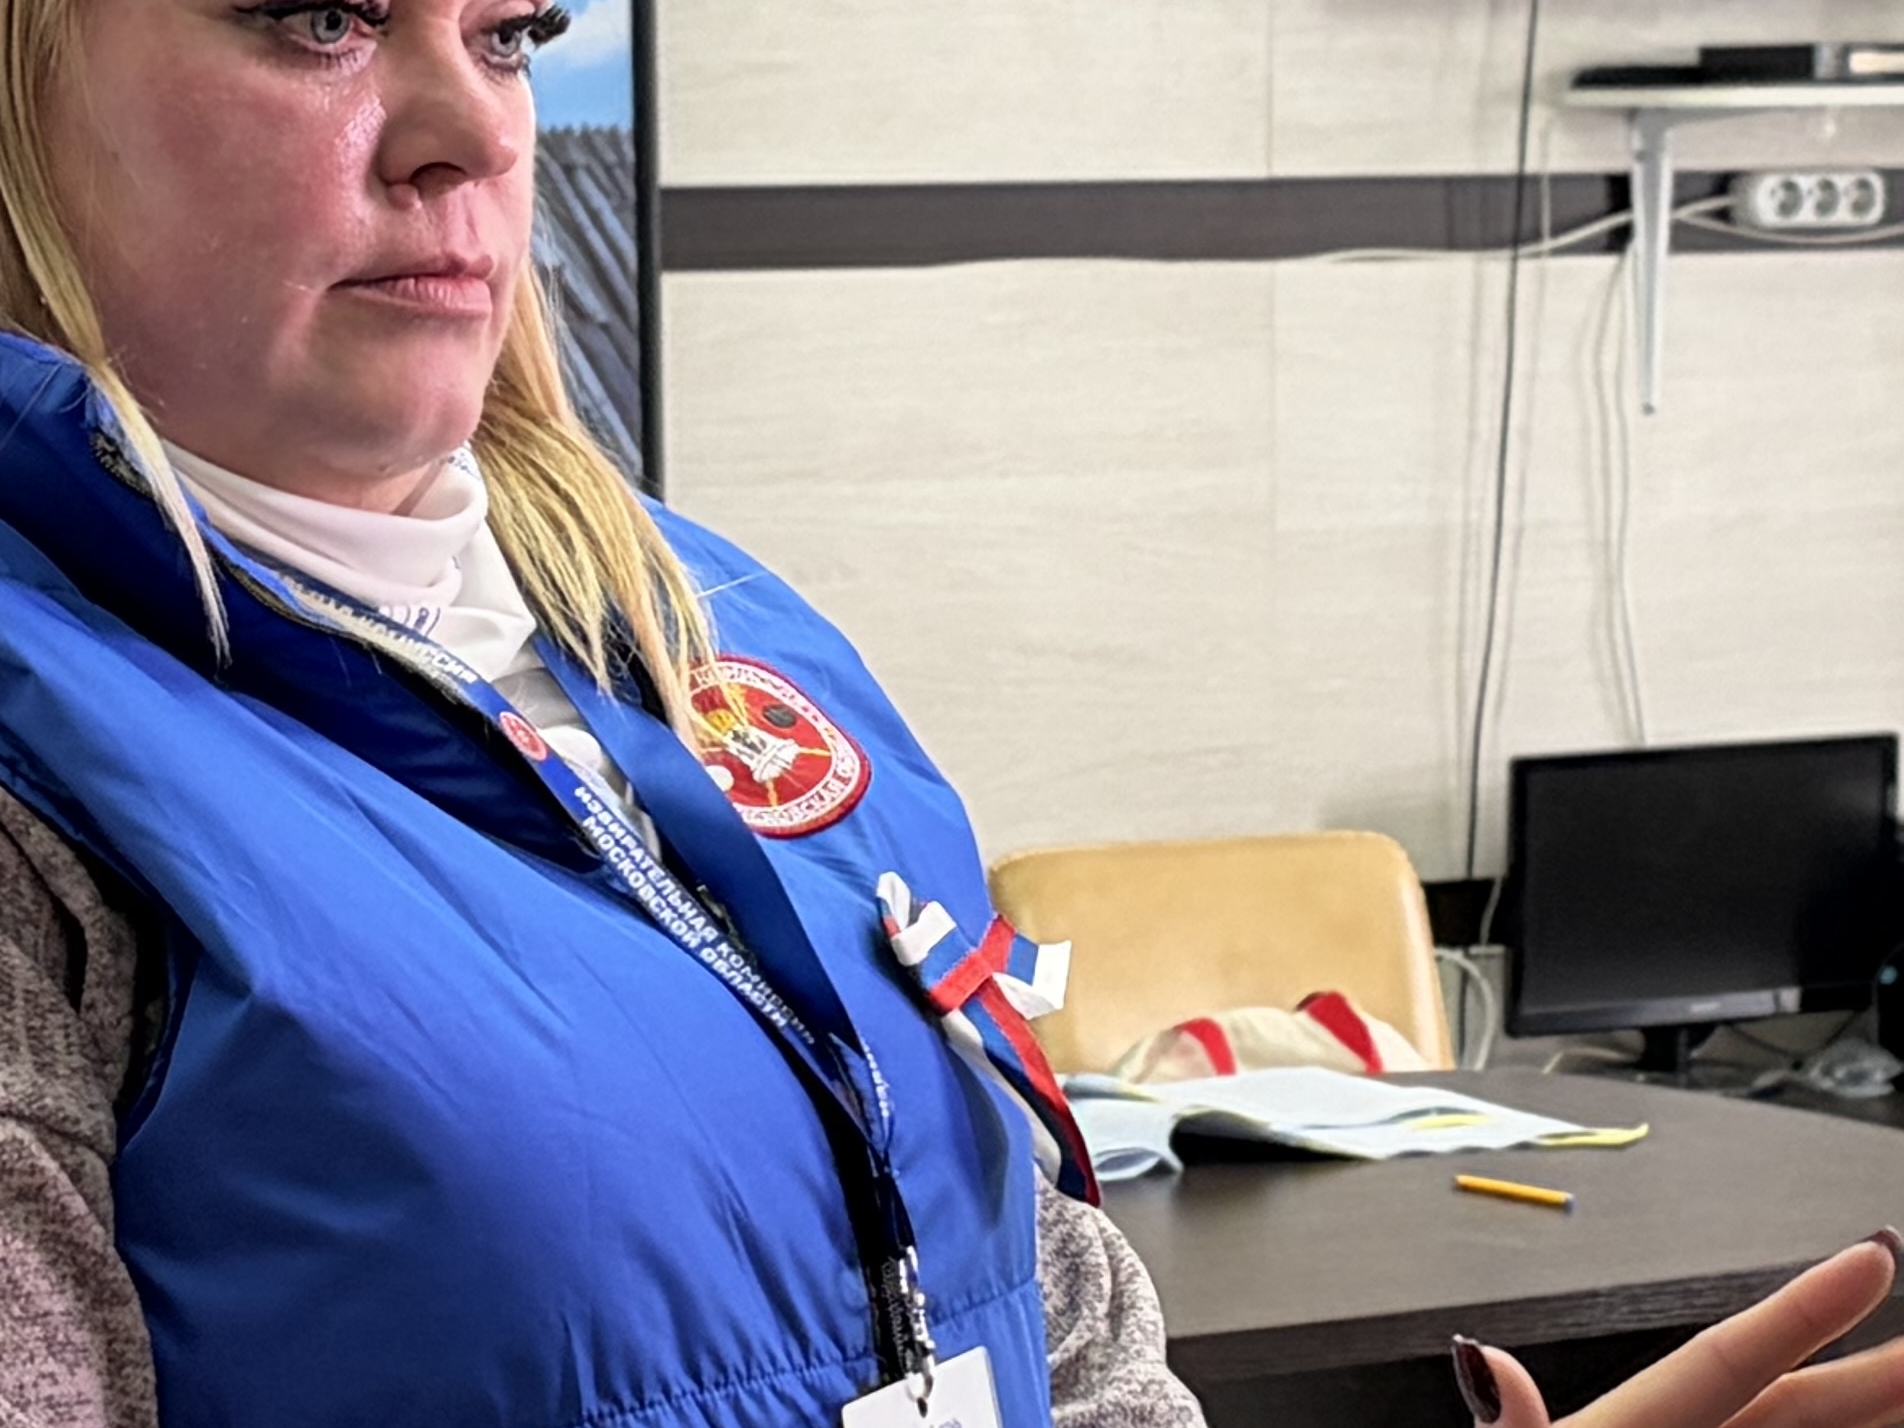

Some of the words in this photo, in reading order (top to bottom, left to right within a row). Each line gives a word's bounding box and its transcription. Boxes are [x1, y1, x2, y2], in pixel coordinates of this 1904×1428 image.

[575, 786, 718, 943] ИЗБИРАТЕЛЬНАЯ
[583, 815, 702, 950] МОСКОВСКОЙ
[699, 947, 789, 1028] ОБЛАСТИ
